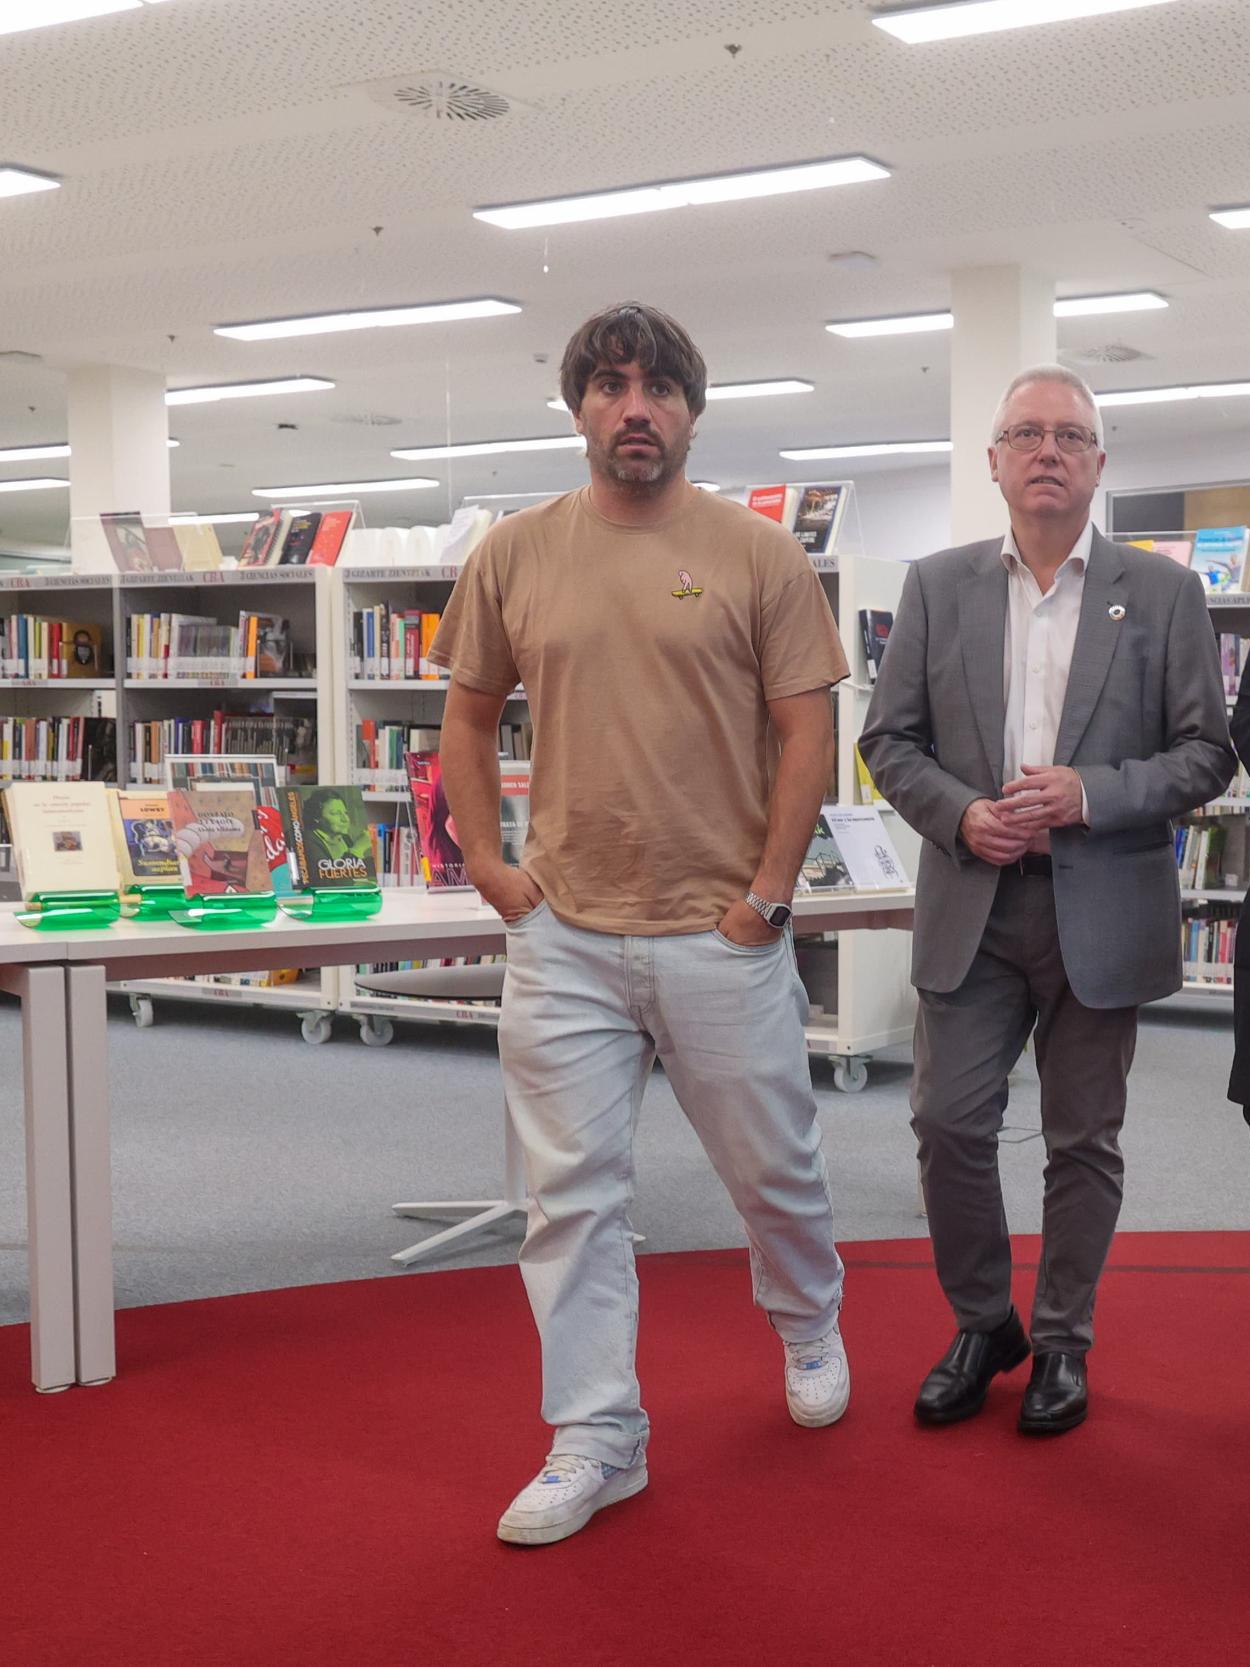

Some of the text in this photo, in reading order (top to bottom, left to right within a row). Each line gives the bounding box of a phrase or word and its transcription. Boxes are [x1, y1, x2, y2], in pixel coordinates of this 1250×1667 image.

[202, 572, 225, 583] CBA
[441, 566, 458, 578] CB
[10, 577, 32, 588] CBA
[318, 857, 367, 869] GLORIA
[319, 867, 368, 880] FUERTES
